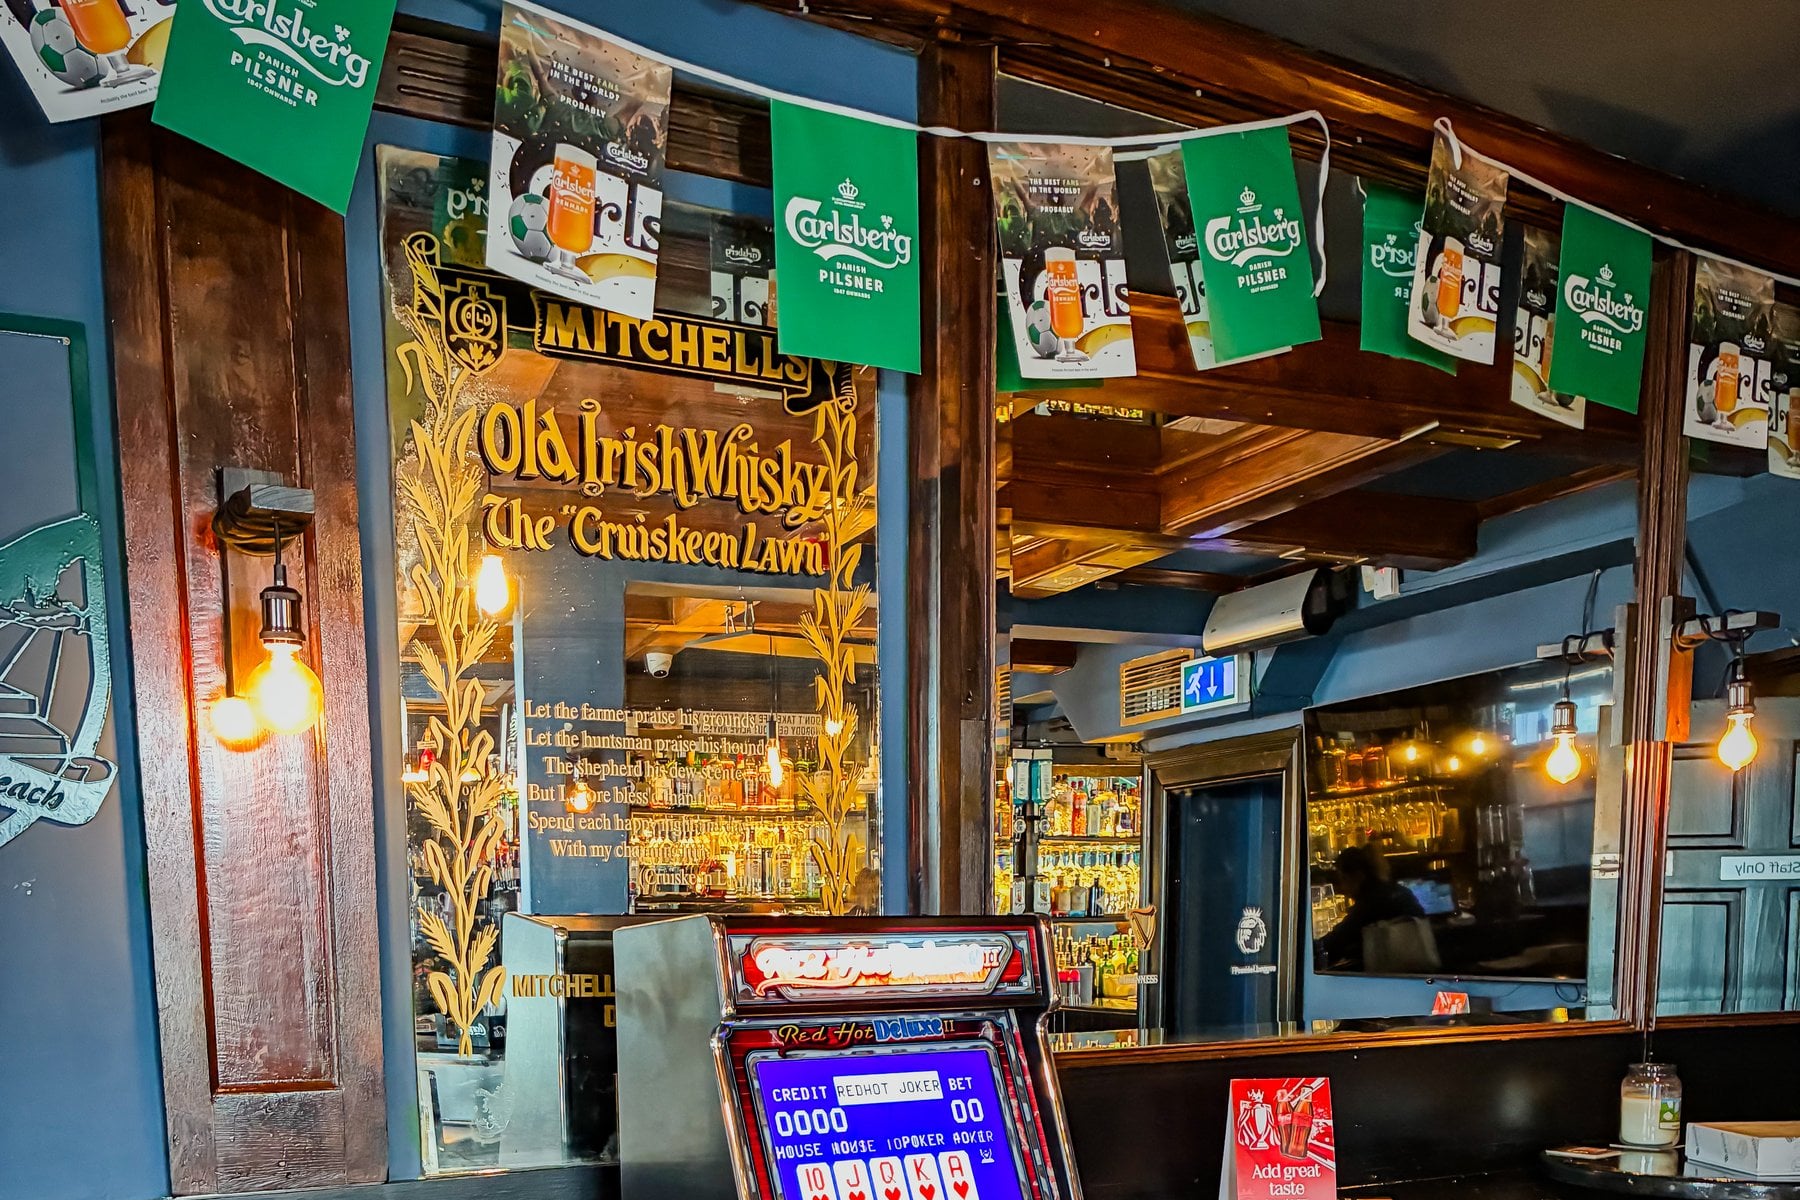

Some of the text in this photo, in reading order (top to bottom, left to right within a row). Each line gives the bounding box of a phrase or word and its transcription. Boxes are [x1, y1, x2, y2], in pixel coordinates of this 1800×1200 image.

[258, 51, 299, 78] DANISH
[552, 61, 619, 92] THE BEST FANS
[230, 50, 319, 107] PILSNER
[550, 70, 620, 101] IN THE WORLD?
[247, 78, 297, 107] 1847 ONWARDS
[560, 94, 606, 119] PROBABLY
[606, 141, 649, 170] Carlsberg
[785, 196, 912, 266] Carlsberg
[1205, 213, 1301, 263] Carlsberg
[819, 269, 884, 293] PILSNER
[836, 261, 867, 274] DANISH
[1237, 267, 1287, 289] PILSNER
[1564, 273, 1644, 332] Carlsberg
[1581, 329, 1622, 351] PILSNER
[479, 399, 835, 529] Old Irish Whisky
[482, 494, 556, 551] The
[526, 700, 551, 719] Let
[554, 702, 579, 719] the
[581, 703, 631, 722] farmer
[635, 708, 676, 726] praise
[679, 709, 699, 725] his
[526, 728, 552, 746] Let
[555, 730, 579, 747] the
[582, 731, 651, 751] huntsman
[656, 735, 697, 756] praise
[701, 736, 719, 754] his
[543, 756, 574, 775] The
[577, 758, 643, 781] shepherd
[528, 784, 554, 802] But
[529, 812, 575, 834] Spend
[580, 813, 611, 830] each
[550, 839, 590, 857] With
[591, 843, 612, 863] my
[779, 1024, 828, 1044] Red
[833, 1021, 875, 1046] Hot
[873, 1017, 943, 1042] Deluxe
[772, 1077, 973, 1102] CREDIT REDHOT JOKER BET
[774, 1098, 984, 1137] 0000 00
[804, 1155, 965, 1192] 10 J Q K A
[1252, 1162, 1321, 1181] Add great
[1269, 1181, 1305, 1196] taste
